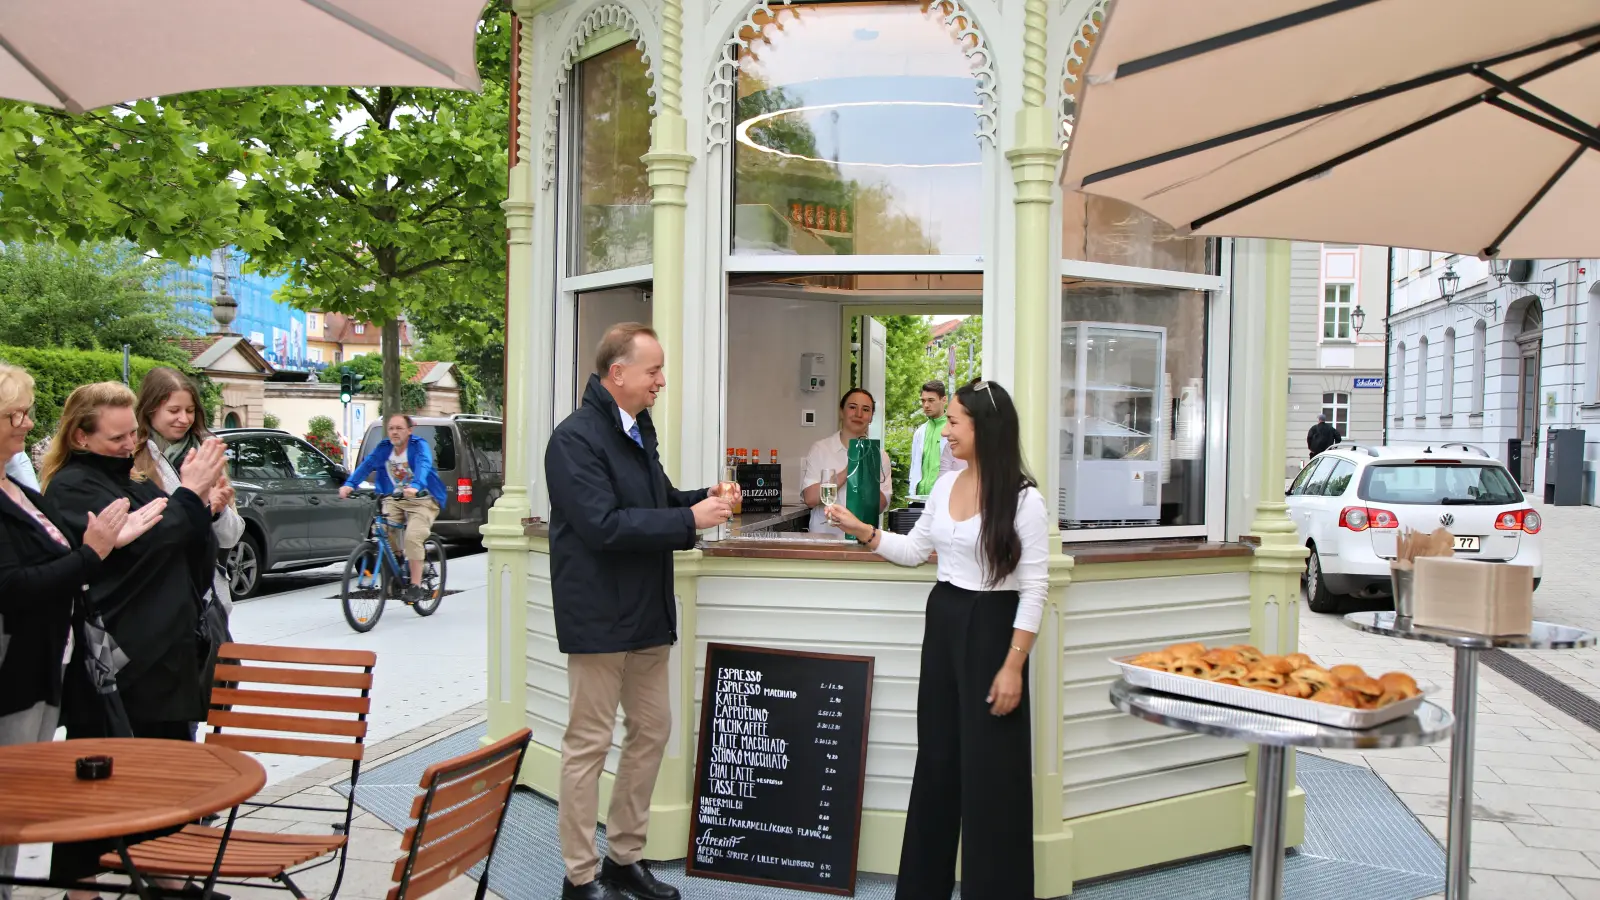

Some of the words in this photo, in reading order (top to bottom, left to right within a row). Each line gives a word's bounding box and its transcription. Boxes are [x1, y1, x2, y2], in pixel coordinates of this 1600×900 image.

[741, 489, 779, 497] BLIZZARD
[1460, 538, 1473, 548] 77
[718, 667, 763, 682] ESPRESSO
[716, 680, 761, 695] ESPRESSO
[763, 688, 797, 699] MACCHIATO
[715, 692, 751, 707] KAFFEE
[714, 704, 769, 722] CAPPUCCINO
[713, 717, 769, 737] MILCHKAFFEE
[712, 732, 738, 748] LATTE
[741, 735, 789, 754] MACCHIATO
[710, 747, 743, 765] SCHOKO
[743, 750, 790, 770] MACCHIATO
[709, 763, 728, 778] CHAI
[730, 765, 756, 783] LATTE
[707, 778, 737, 797] TASSE
[737, 781, 757, 799] TEE
[700, 796, 743, 809] HAFERMILCH
[697, 845, 724, 858] APEROL
[726, 850, 749, 861] SPRITZ
[757, 854, 780, 865] LILLET
